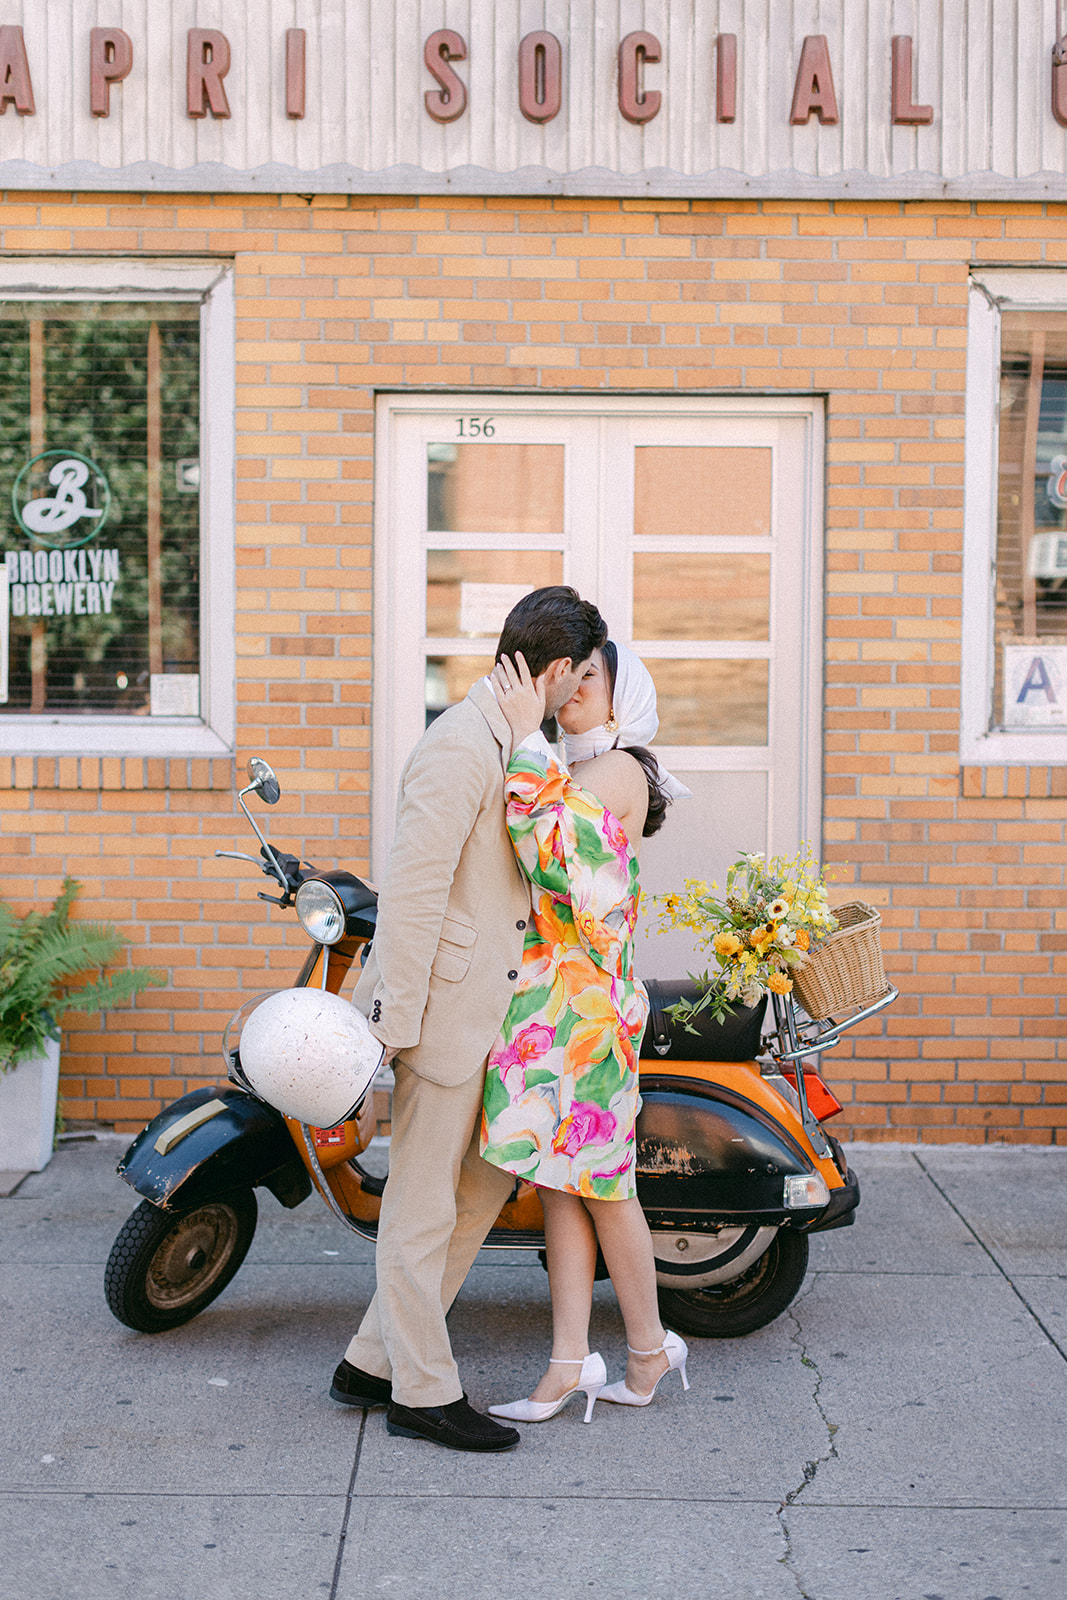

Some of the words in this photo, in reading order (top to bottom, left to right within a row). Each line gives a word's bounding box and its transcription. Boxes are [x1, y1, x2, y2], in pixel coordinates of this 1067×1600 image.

[0, 25, 307, 119] APRI
[424, 28, 932, 126] SOCIAL
[456, 417, 495, 437] 156
[5, 549, 119, 583] BROOKLYN
[12, 581, 115, 616] BREWERY
[1016, 657, 1057, 703] A
